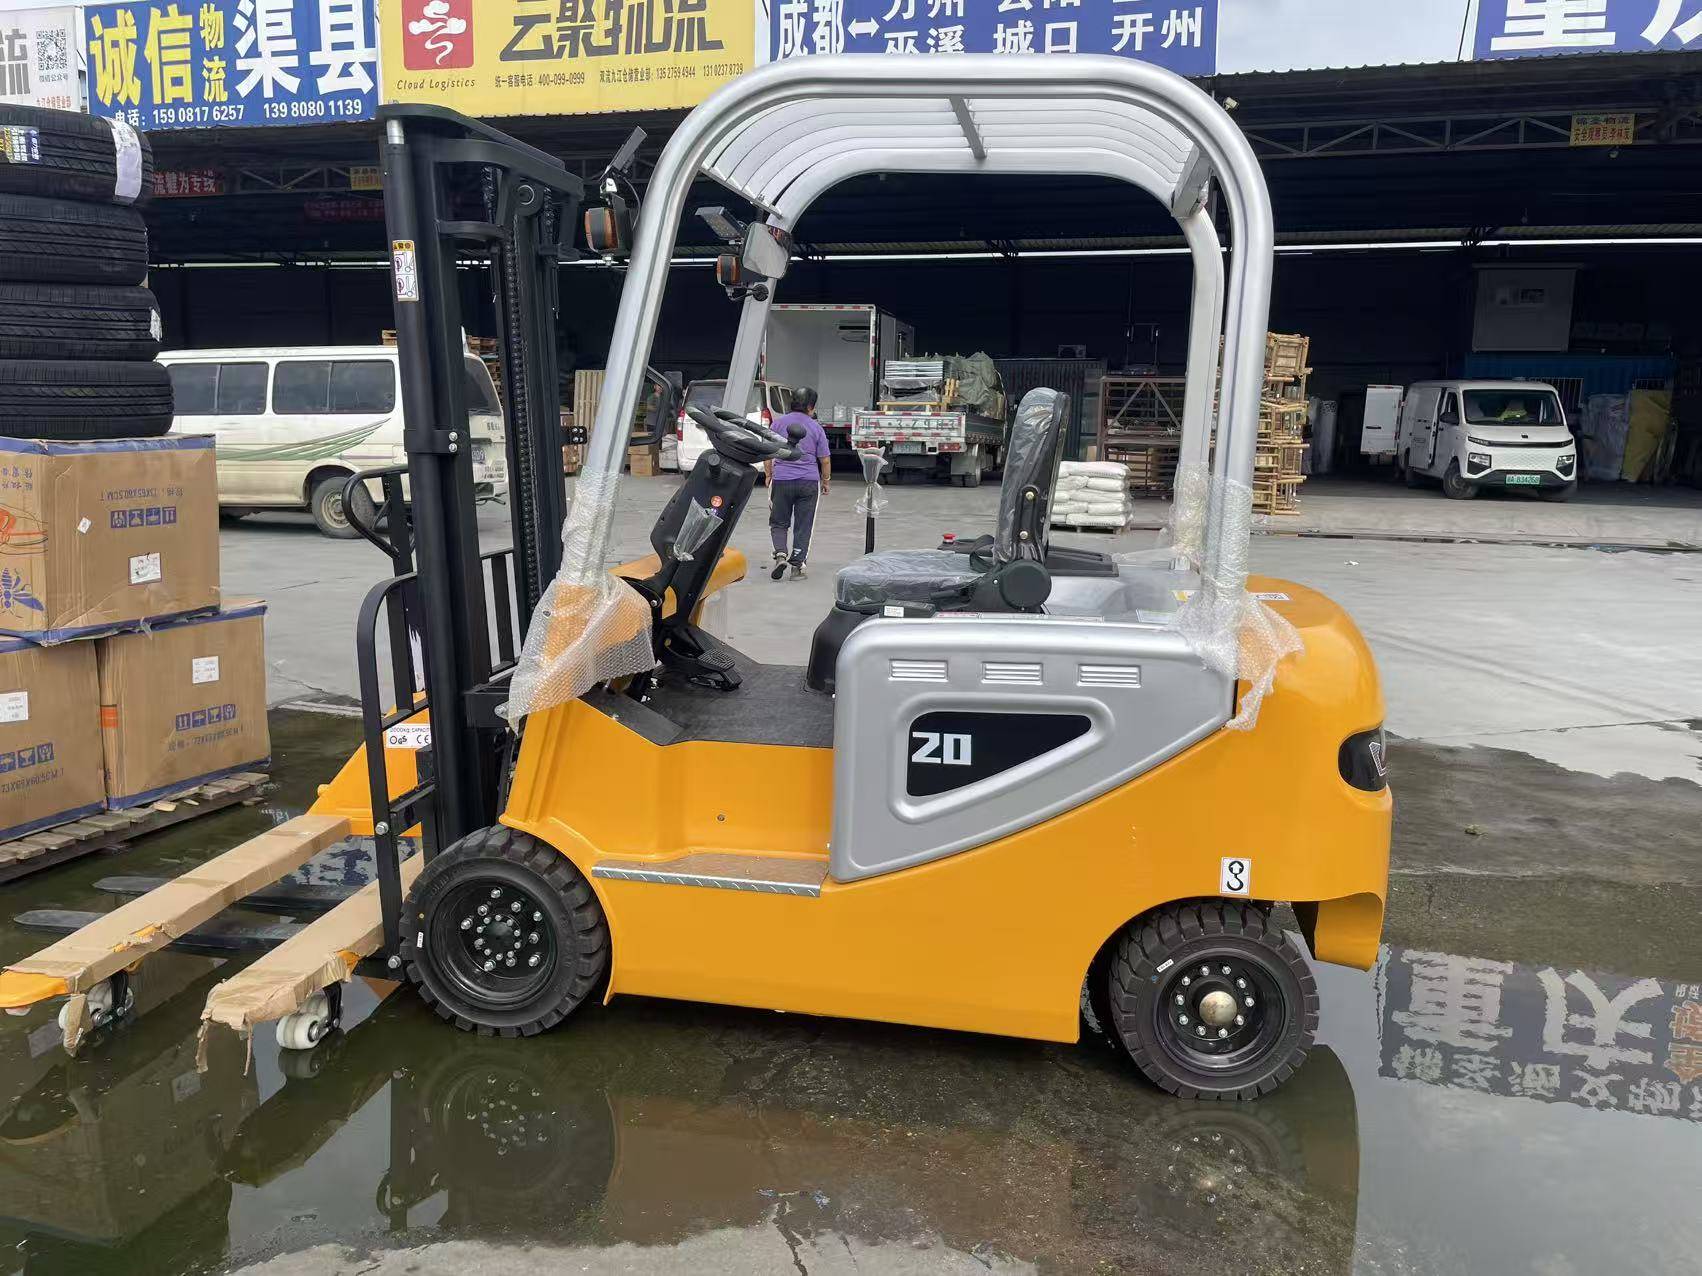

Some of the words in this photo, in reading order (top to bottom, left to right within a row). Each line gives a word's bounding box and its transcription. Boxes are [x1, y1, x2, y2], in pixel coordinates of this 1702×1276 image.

[89, 3, 194, 107] 诚信
[201, 3, 228, 103] 物流
[232, 0, 378, 99] 渠县
[499, 0, 725, 62] 云聚物流
[777, 0, 845, 61] 成都
[992, 19, 1078, 54] 城口
[1111, 7, 1203, 52] 开州
[153, 108, 175, 124] 159
[178, 107, 209, 122] 0817
[212, 105, 244, 121] 6257
[263, 102, 287, 118] 139
[291, 100, 325, 117] 8080
[328, 99, 362, 115] 1139
[397, 78, 425, 91] Cloud
[428, 77, 476, 91] Logistics
[911, 731, 972, 766] 20
